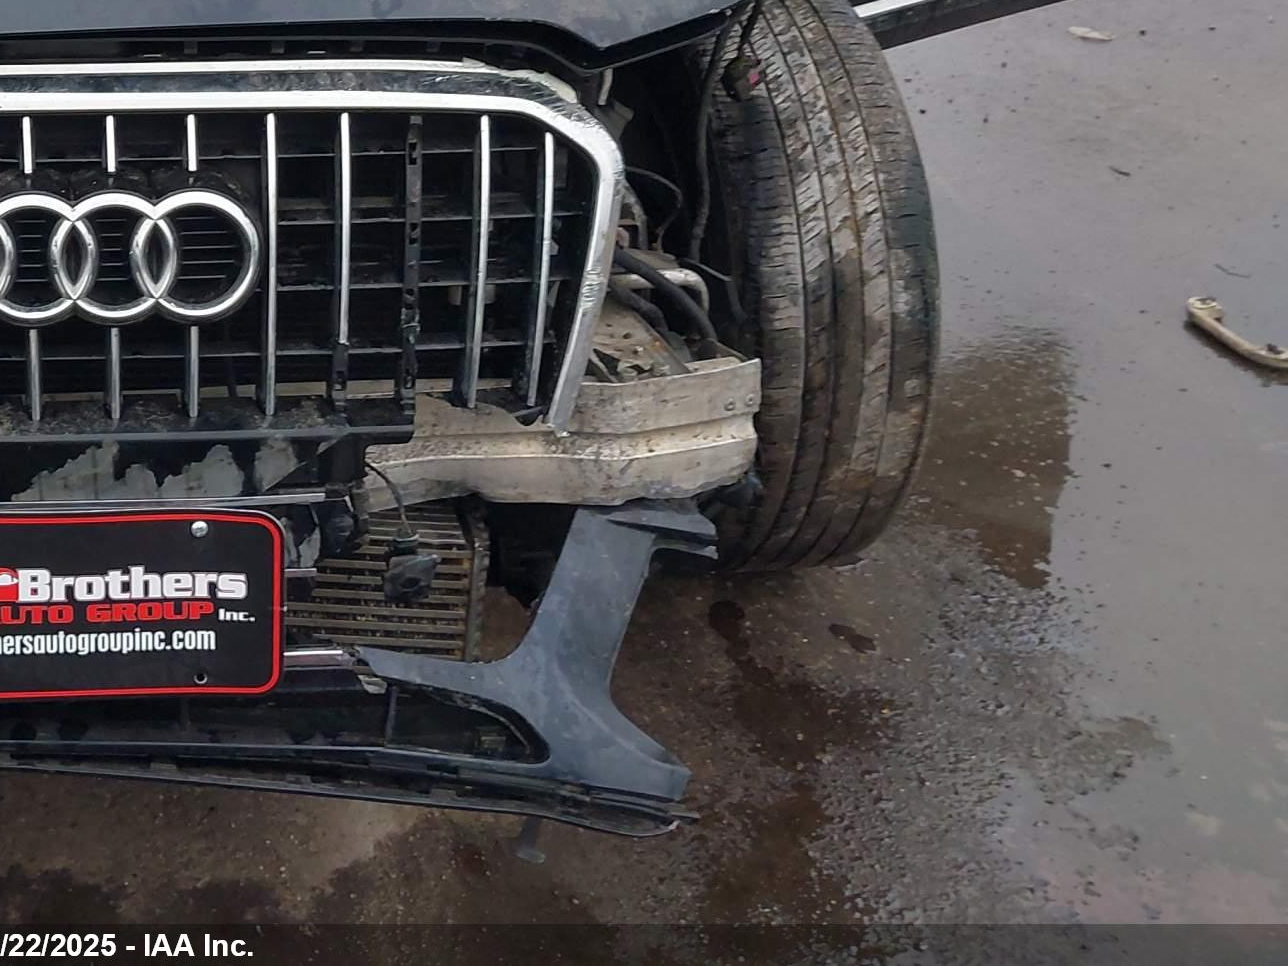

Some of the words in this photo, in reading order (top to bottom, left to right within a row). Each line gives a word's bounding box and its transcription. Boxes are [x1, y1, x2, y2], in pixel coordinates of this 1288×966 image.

[16, 565, 248, 603] Brothers
[85, 600, 216, 622] GROUP
[218, 606, 256, 622] Inc.
